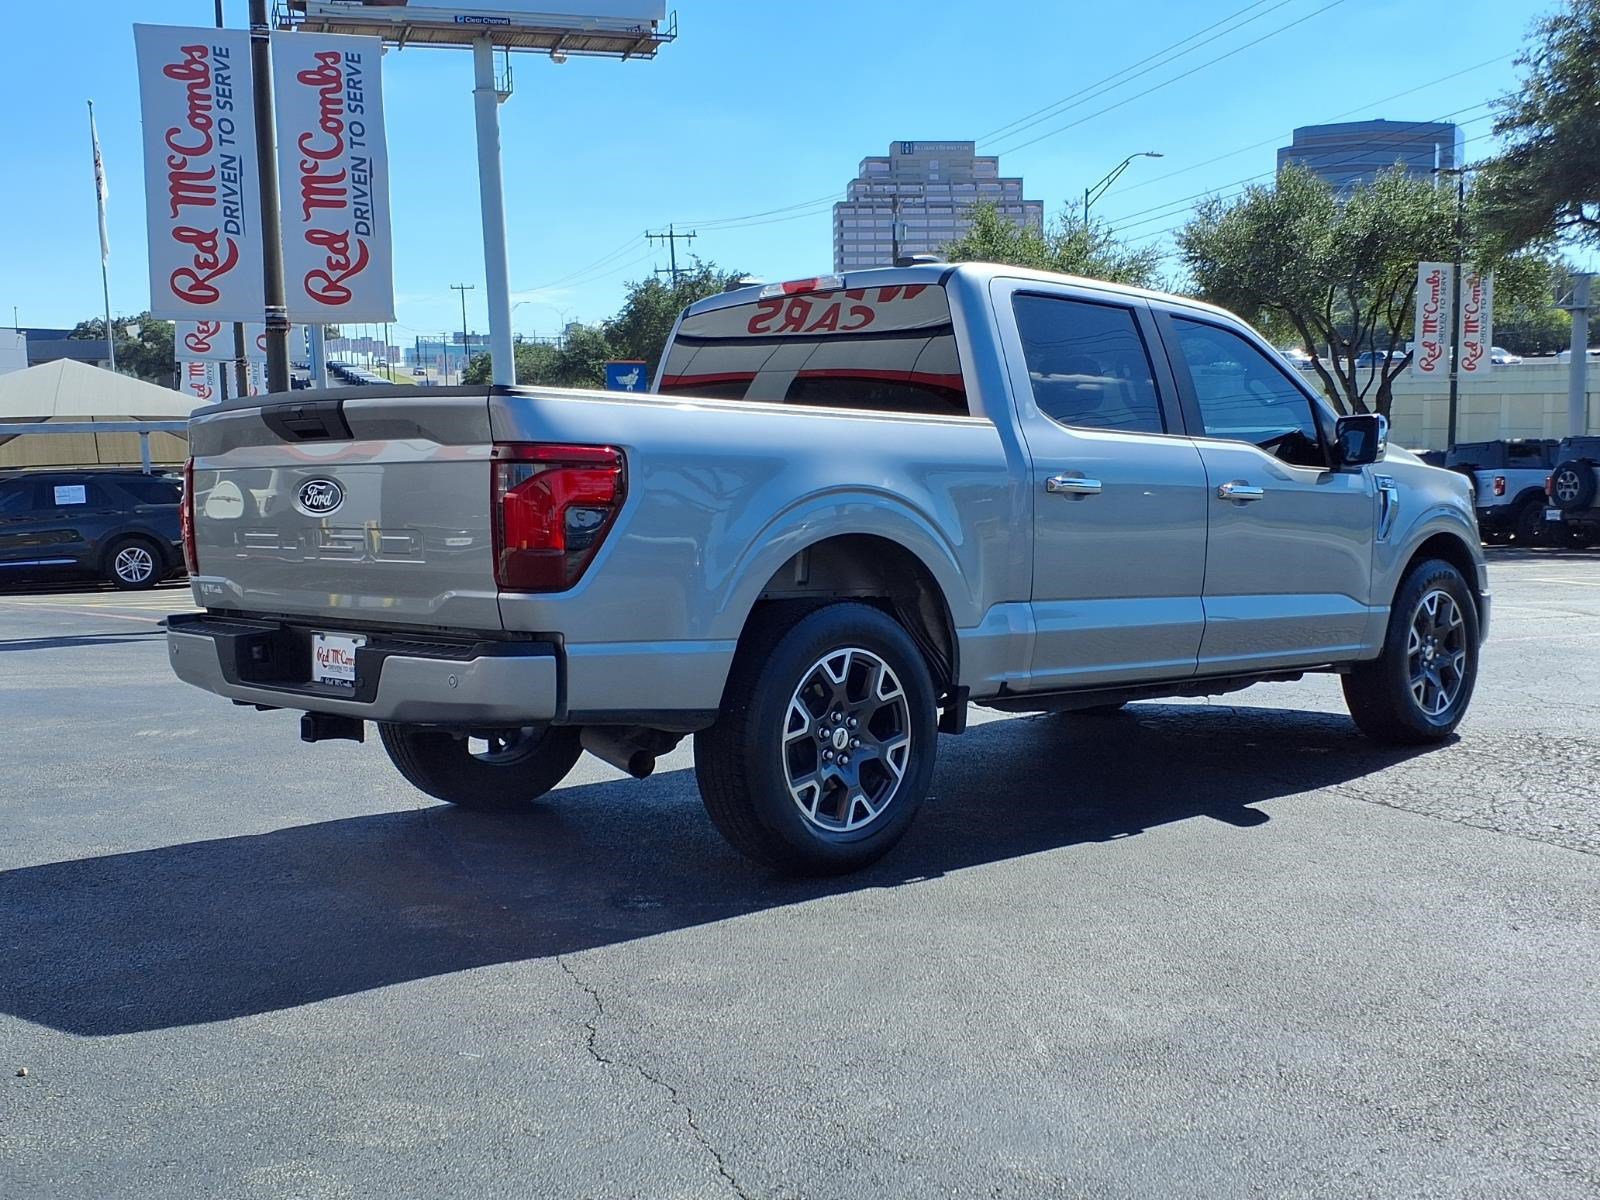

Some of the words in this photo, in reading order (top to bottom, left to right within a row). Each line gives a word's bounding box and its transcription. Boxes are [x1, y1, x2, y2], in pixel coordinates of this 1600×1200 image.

[482, 17, 510, 25] Channel
[212, 45, 234, 112] SERVE
[345, 52, 364, 115] SERVE
[163, 44, 216, 219] McCombs
[217, 119, 235, 147] TO
[297, 51, 347, 222] McCombs
[348, 121, 365, 149] TO
[218, 154, 242, 237] DRIVEN
[350, 156, 371, 238] DRIVEN
[170, 226, 239, 305] Red
[304, 229, 369, 305] Red
[1422, 270, 1440, 338] McCombs
[1440, 298, 1446, 310] TO
[1481, 299, 1487, 311] TO
[185, 320, 221, 353] Re
[1438, 312, 1446, 345] DRIVEN
[1419, 341, 1442, 372] Red
[1461, 341, 1483, 371] Red
[305, 485, 334, 506] Ford
[317, 646, 330, 668] Red
